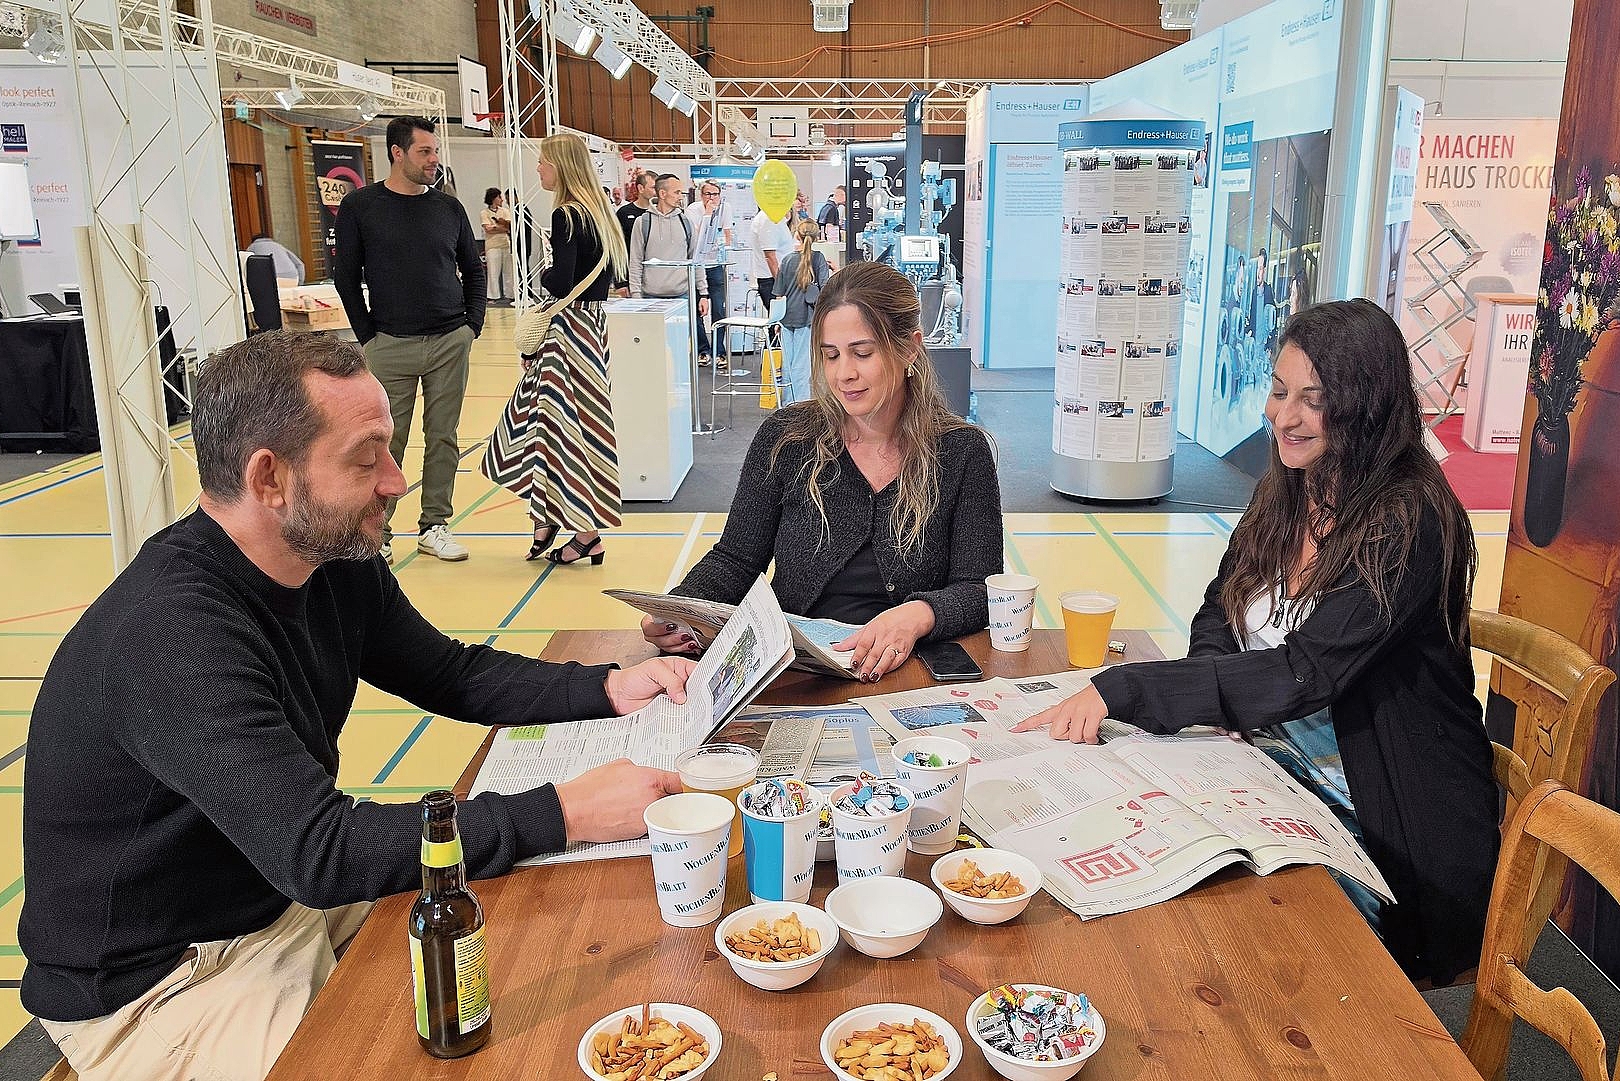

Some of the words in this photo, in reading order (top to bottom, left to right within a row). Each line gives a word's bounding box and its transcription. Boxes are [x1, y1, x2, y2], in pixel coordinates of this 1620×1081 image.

[255, 0, 283, 19] RAUCHEN
[284, 10, 313, 30] VERBOTEN
[23, 86, 55, 100] perfect
[996, 101, 1060, 111] Endress+Hauser
[2, 126, 25, 137] hell
[1127, 130, 1189, 140] Endress+Hauser
[1432, 135, 1515, 159] MACHEN
[1425, 165, 1477, 189] HAUS
[36, 183, 68, 195] perfect
[322, 181, 346, 195] 240
[1505, 313, 1535, 330] WIR
[1503, 334, 1529, 350] IHR
[912, 774, 960, 801] OCHENBLATT
